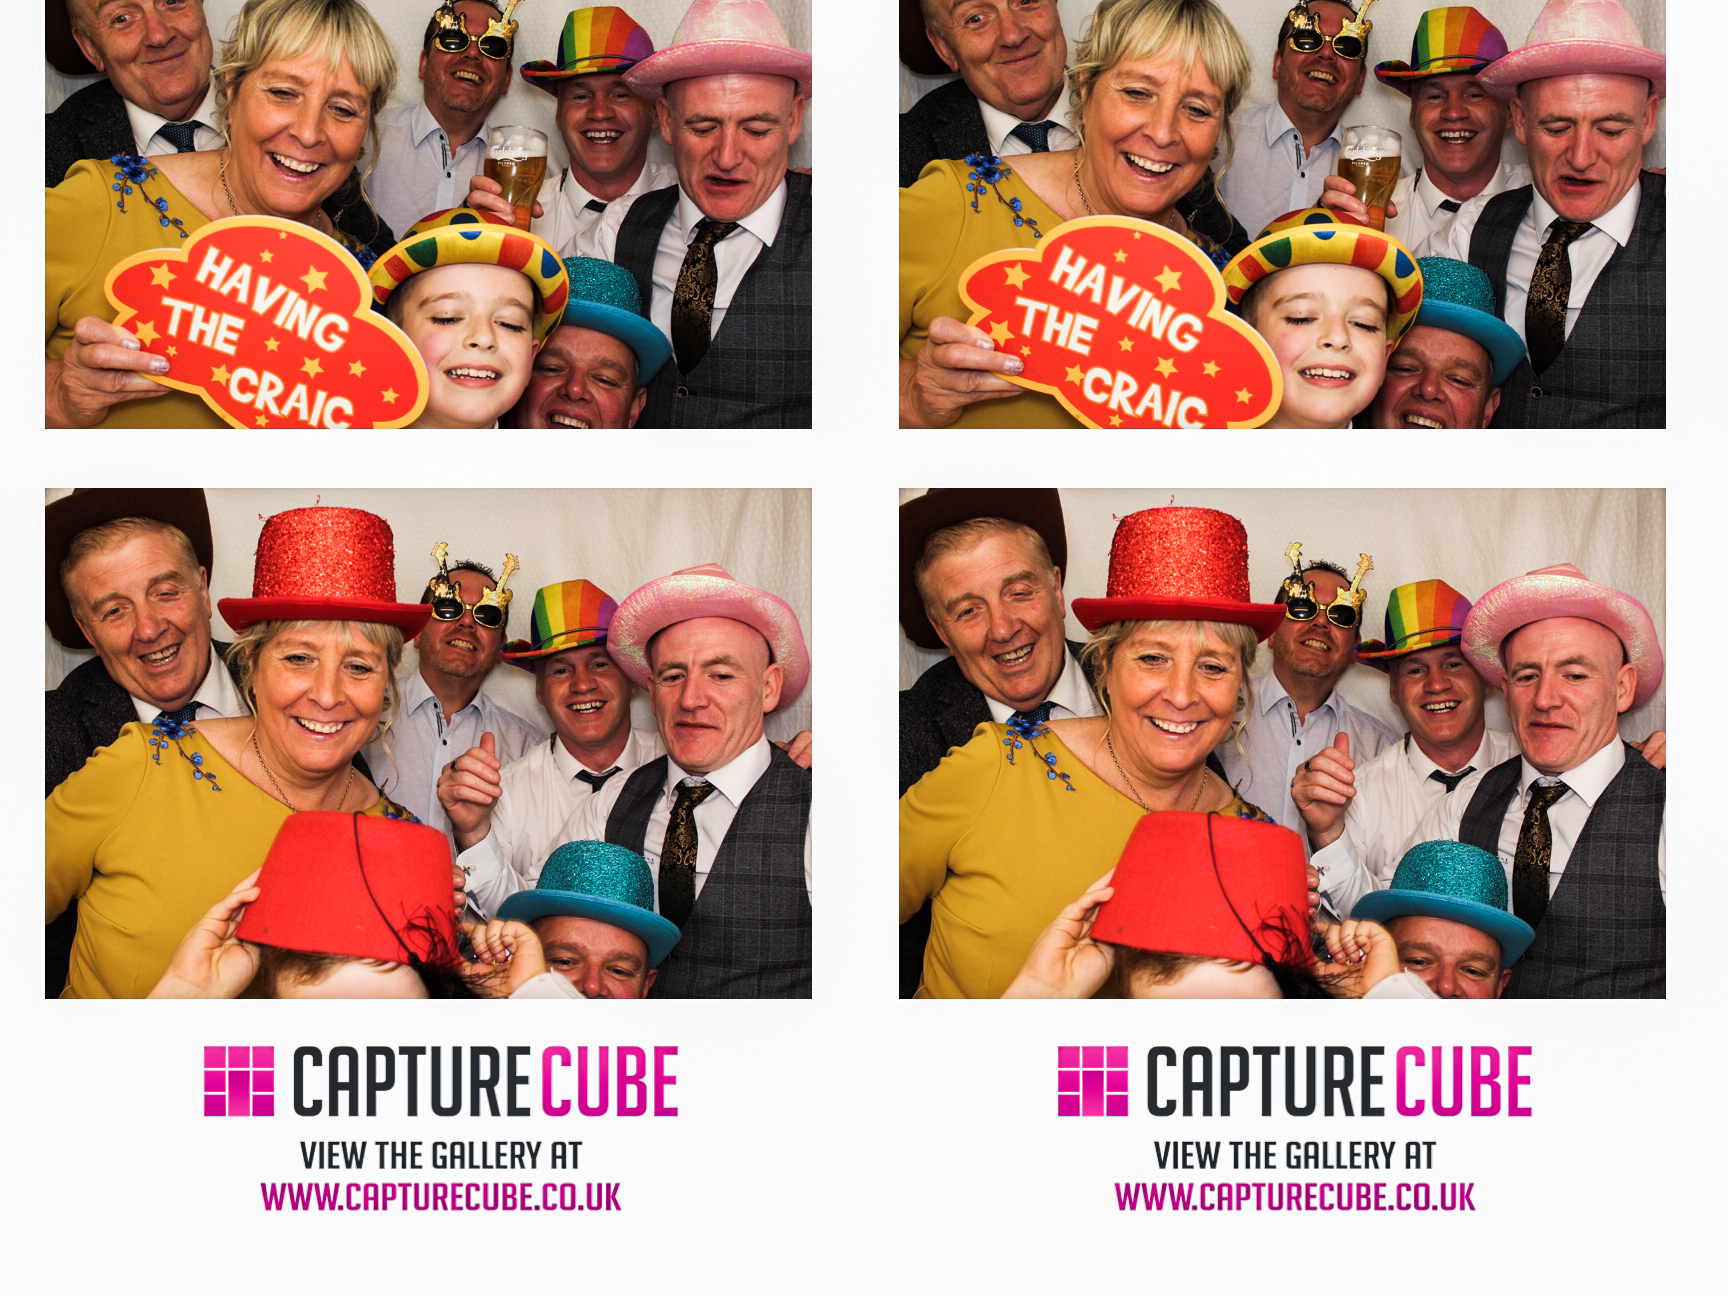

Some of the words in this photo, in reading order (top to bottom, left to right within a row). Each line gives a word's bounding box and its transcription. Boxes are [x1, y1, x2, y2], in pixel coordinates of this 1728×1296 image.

[160, 295, 246, 356] THE
[195, 244, 349, 353] HAVING
[1014, 295, 1100, 356] THE
[1049, 244, 1203, 353] HAVING
[229, 366, 354, 429] CRAIC
[1083, 366, 1208, 429] CRAIC
